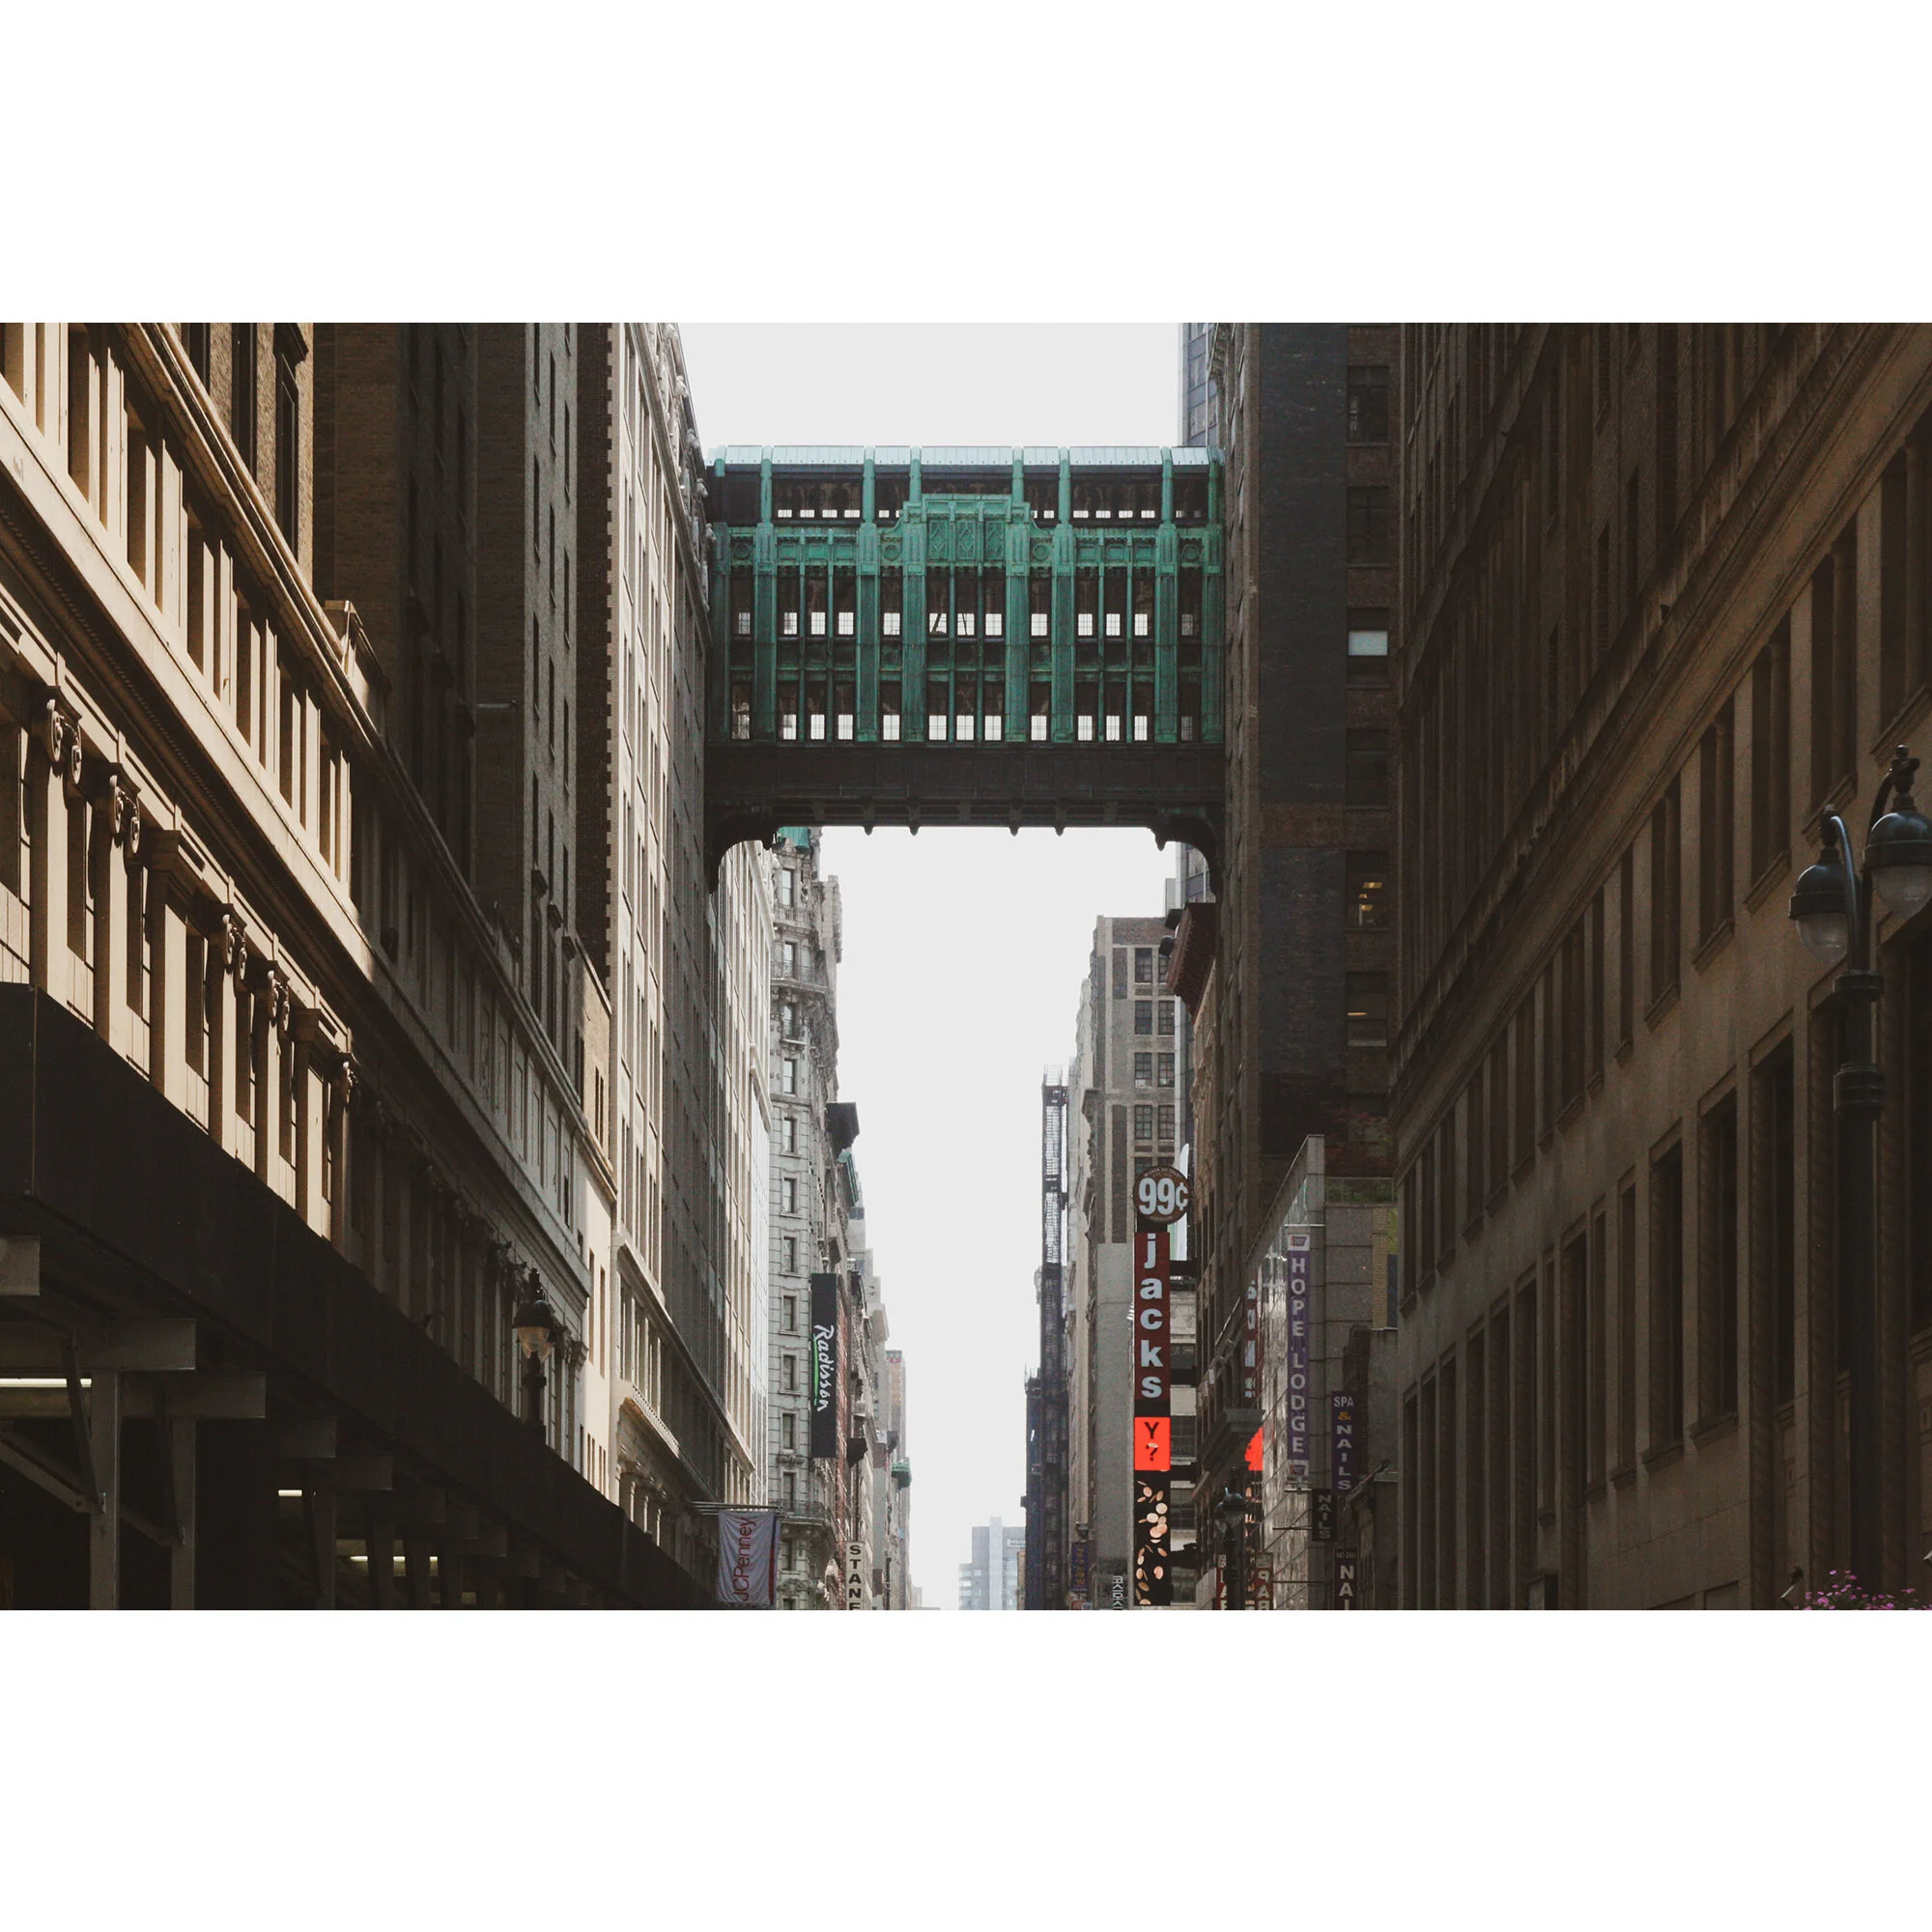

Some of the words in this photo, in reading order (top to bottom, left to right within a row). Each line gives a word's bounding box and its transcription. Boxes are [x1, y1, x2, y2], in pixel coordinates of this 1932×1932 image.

[1139, 1177, 1188, 1215] 99¢
[1140, 1233, 1164, 1398] jacks
[1291, 1258, 1306, 1336] HOPE
[813, 1324, 835, 1411] Radisson
[1291, 1352, 1306, 1453] LODGE
[1333, 1396, 1354, 1407] SPA
[1337, 1425, 1352, 1490] NAILS
[1318, 1494, 1332, 1539] NAILS
[733, 1517, 756, 1602] JCPenney
